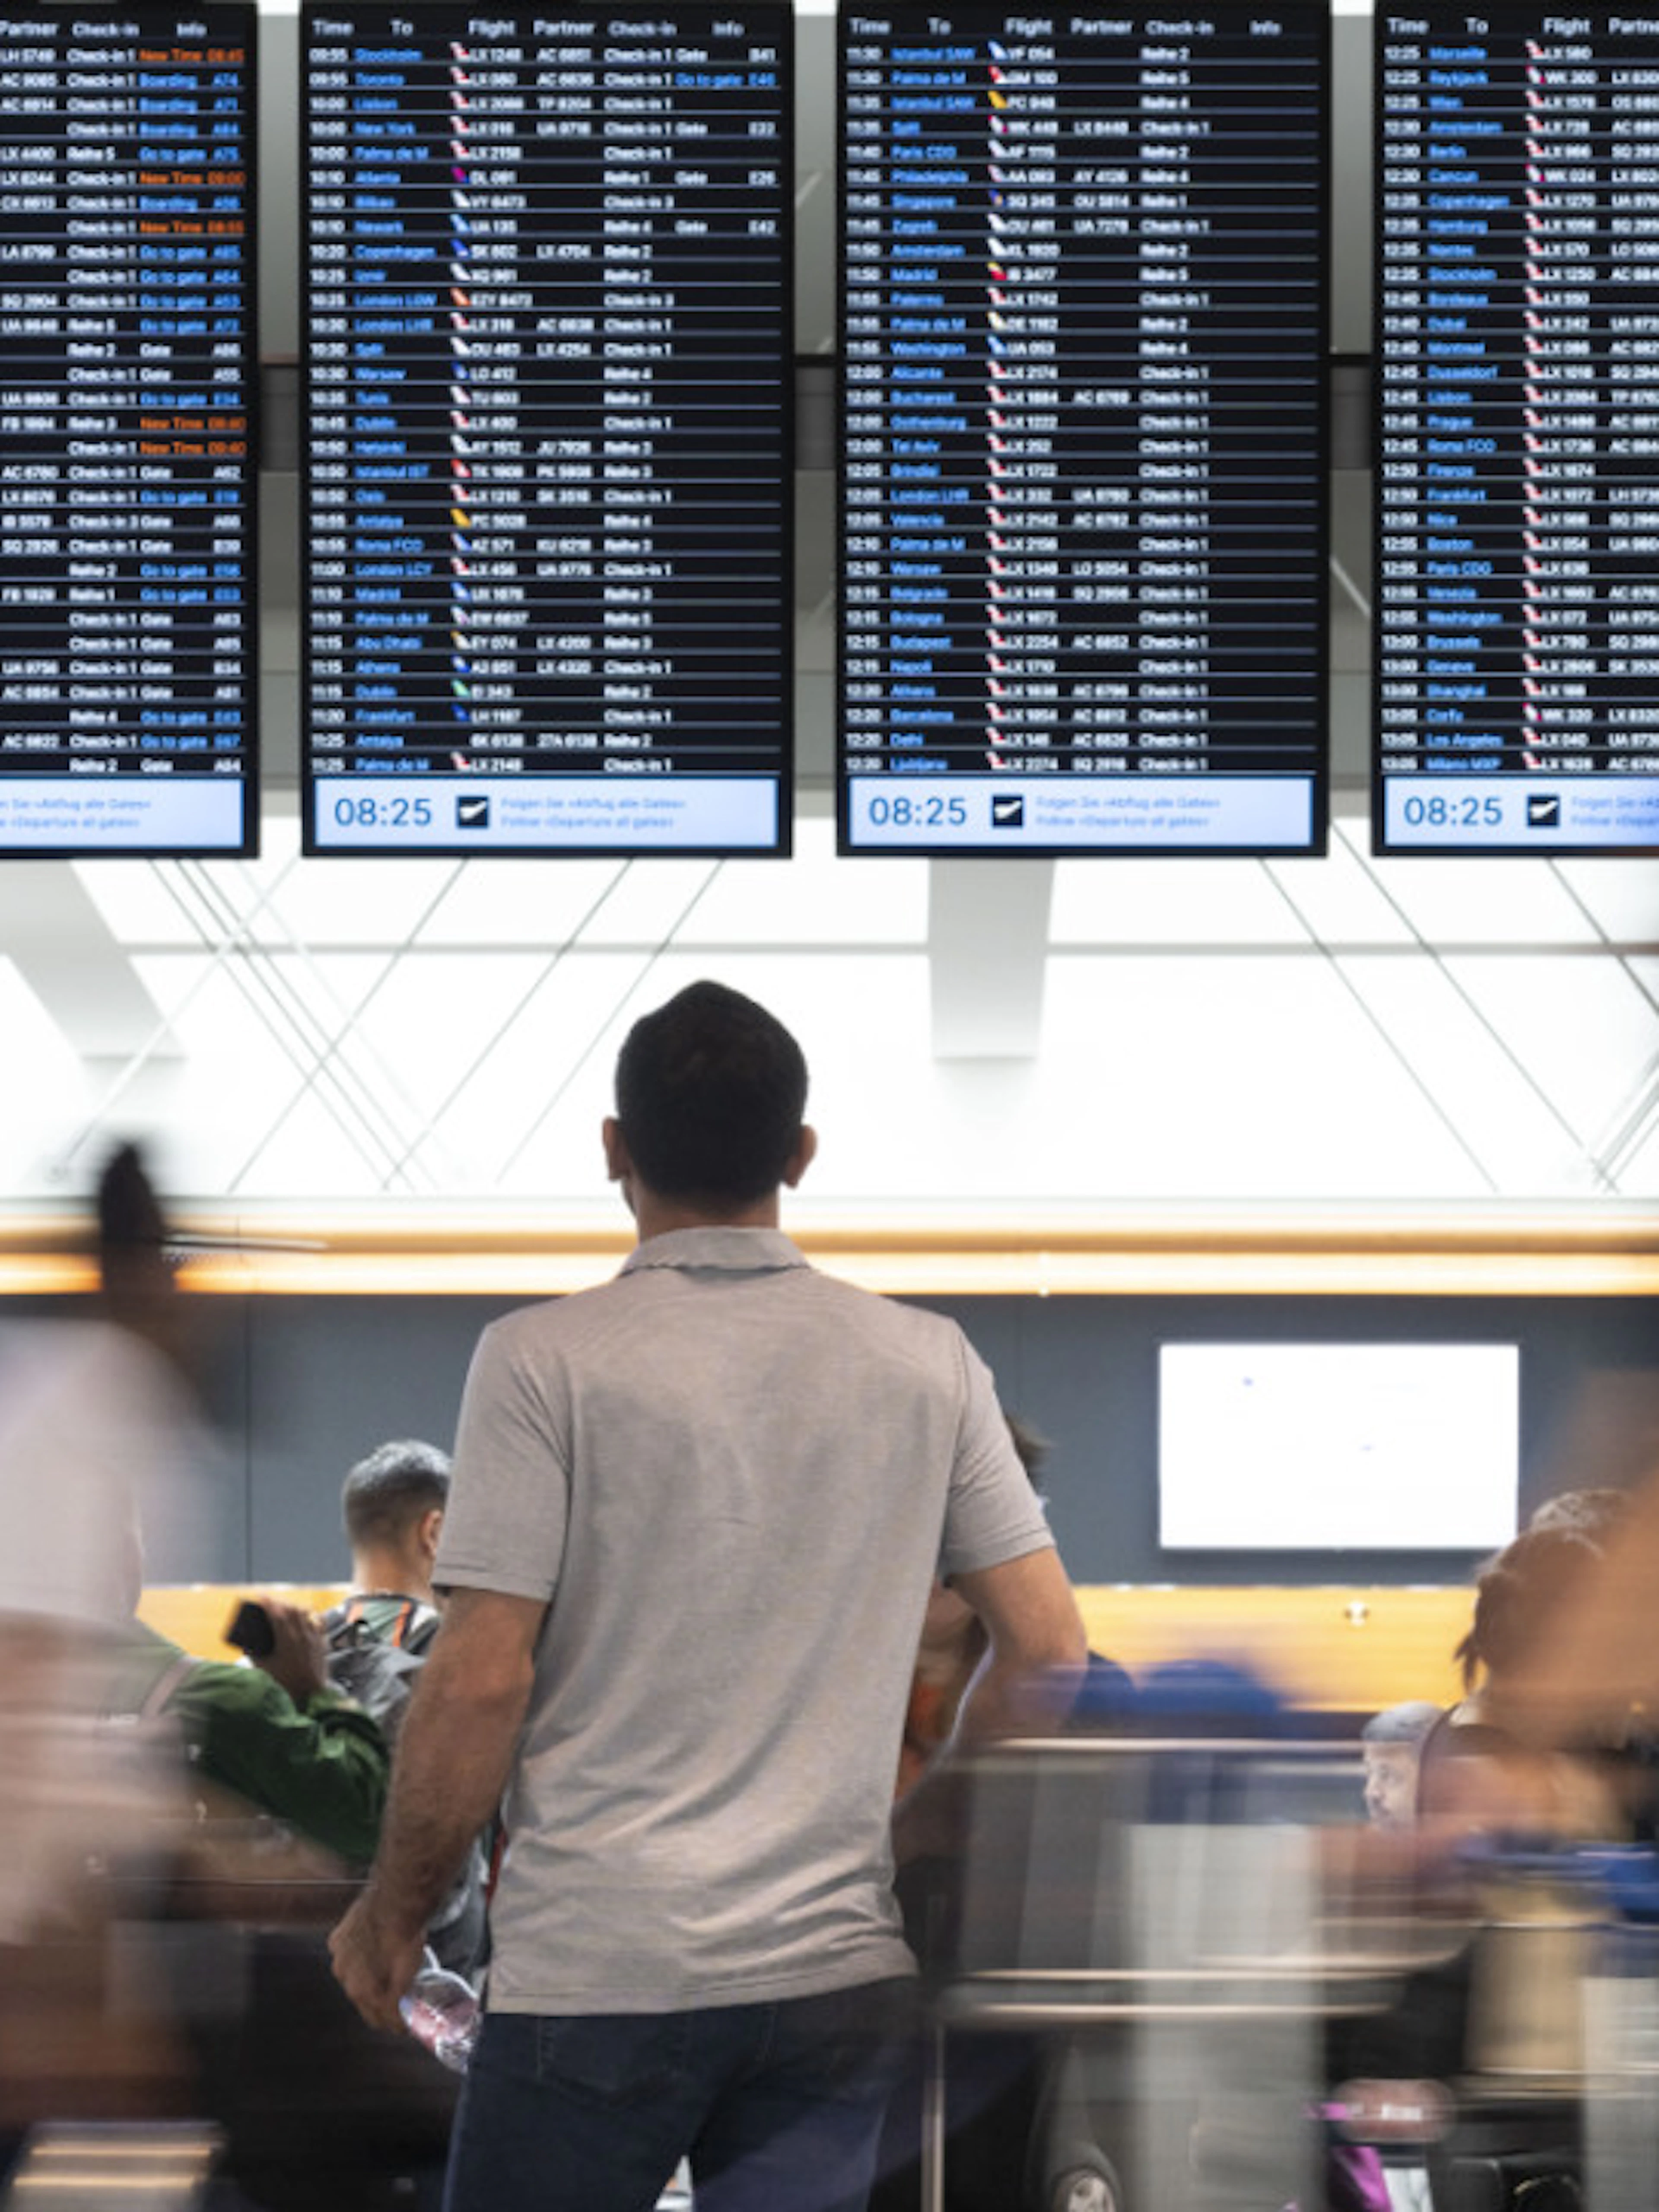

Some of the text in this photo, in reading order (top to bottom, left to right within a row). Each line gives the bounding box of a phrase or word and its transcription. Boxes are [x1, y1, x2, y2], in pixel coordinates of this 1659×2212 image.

[72, 22, 140, 37] Check-in
[176, 22, 207, 37] Info
[312, 20, 744, 38] Time To Flight Partner Check-in Info
[849, 17, 1282, 37] Time To Flight Partner Check-in Info
[1386, 17, 1428, 34] Time
[1465, 17, 1489, 34] To
[1544, 17, 1591, 36] Flight
[335, 798, 432, 826] 08:25
[869, 797, 966, 826] 08:25
[1404, 797, 1502, 826] 08:25
